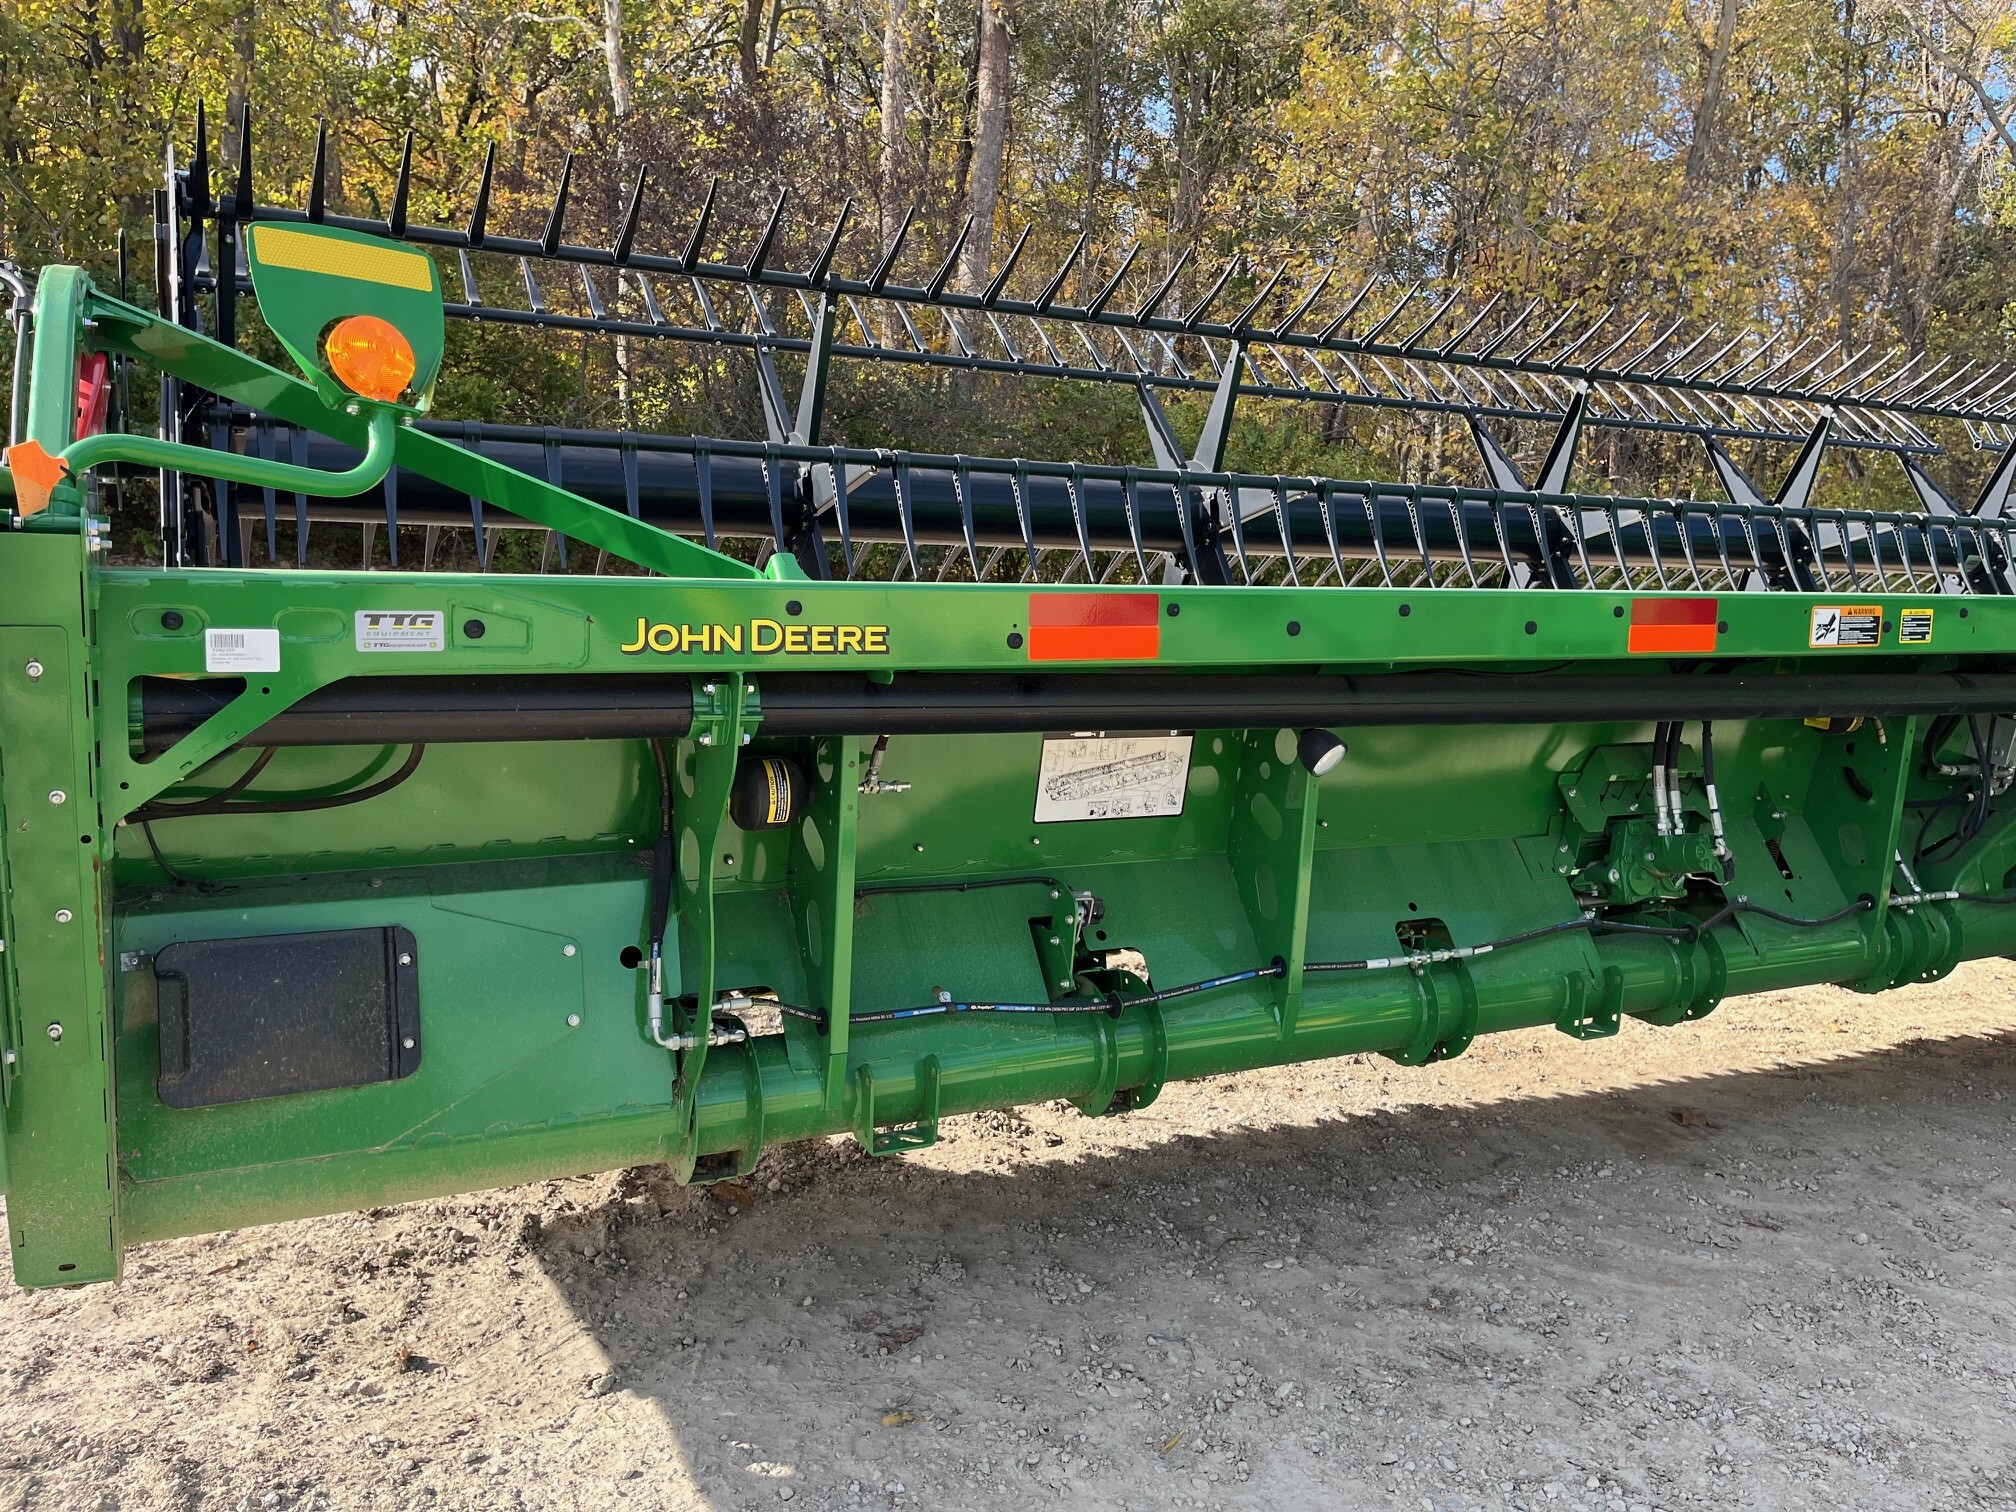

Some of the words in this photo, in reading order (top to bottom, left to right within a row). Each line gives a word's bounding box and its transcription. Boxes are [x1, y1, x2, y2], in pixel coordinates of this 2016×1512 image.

[364, 614, 434, 629] TTG
[620, 617, 745, 655] JOHN
[750, 618, 890, 655] DEERE
